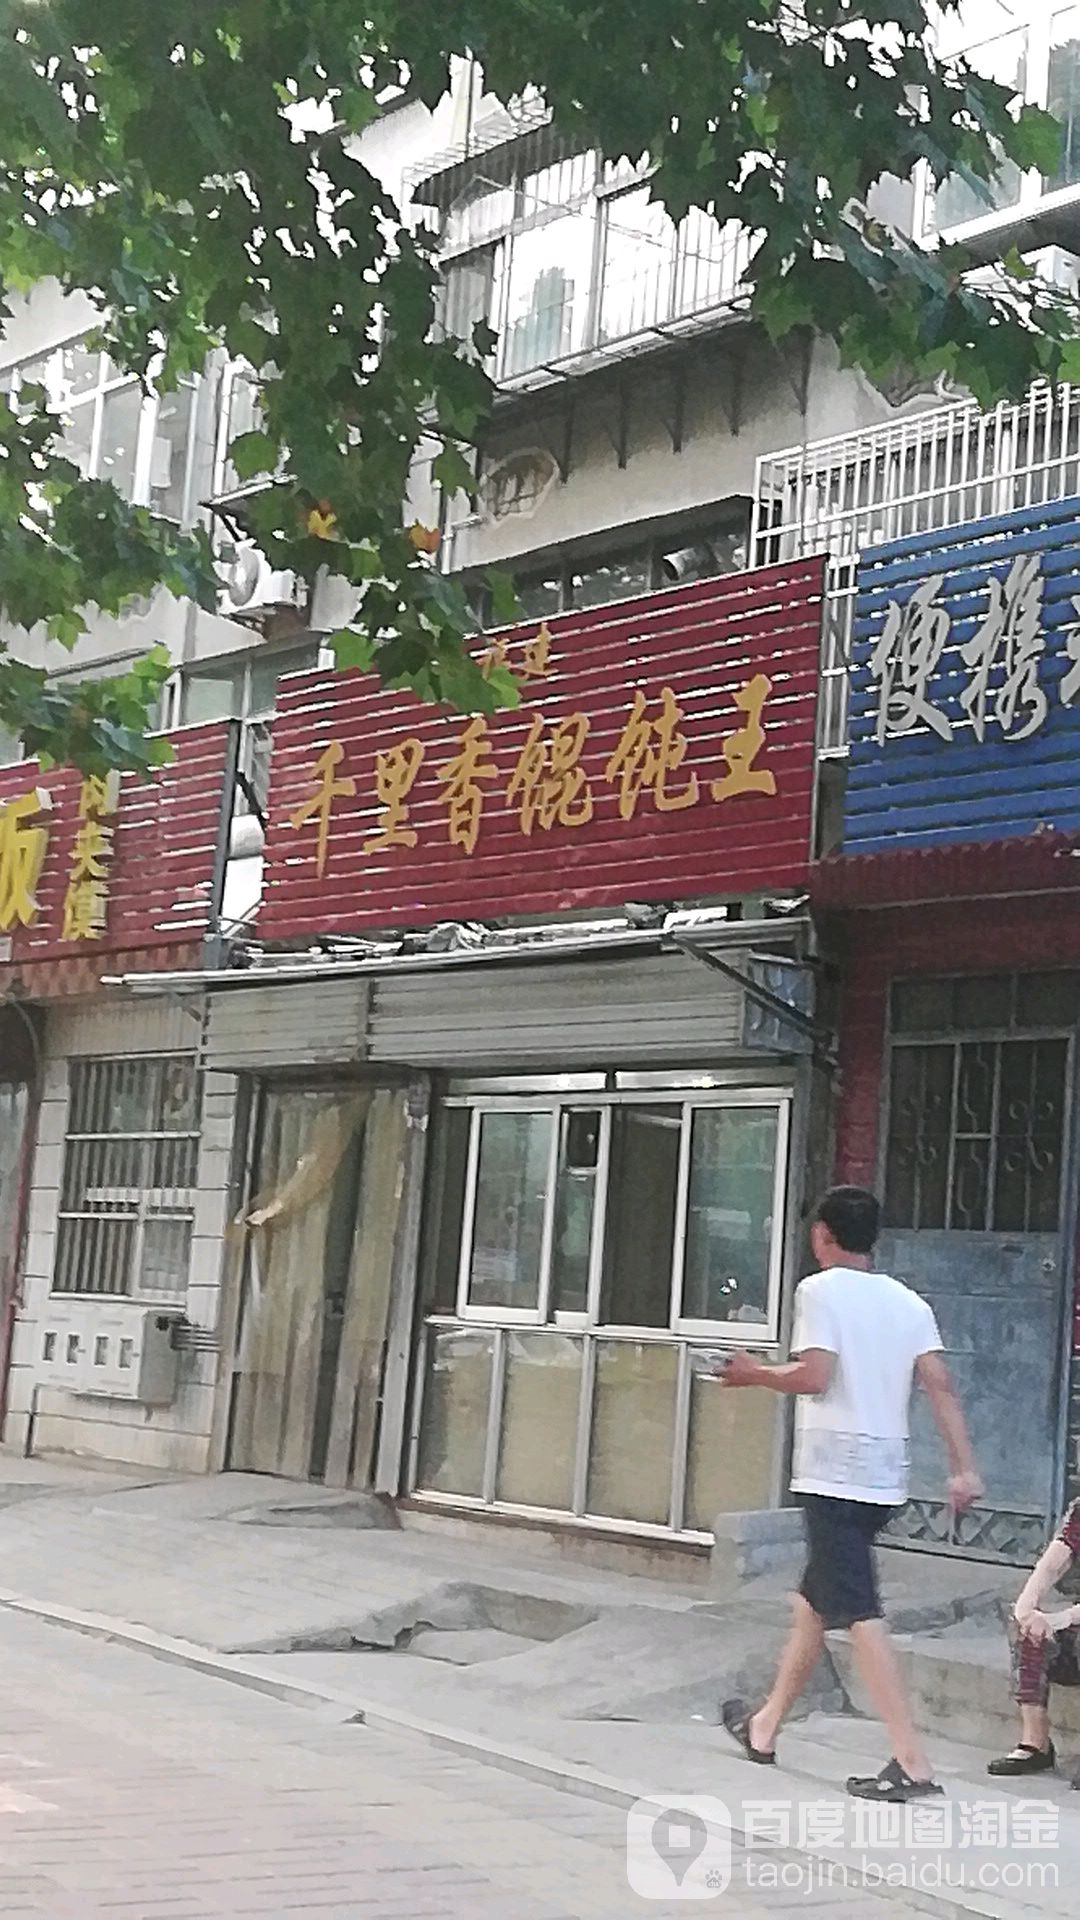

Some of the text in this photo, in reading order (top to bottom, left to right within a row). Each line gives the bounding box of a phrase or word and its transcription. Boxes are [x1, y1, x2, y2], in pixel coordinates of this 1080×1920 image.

[871, 551, 1080, 748] 便携
[290, 673, 778, 879] 千里香馄饨王
